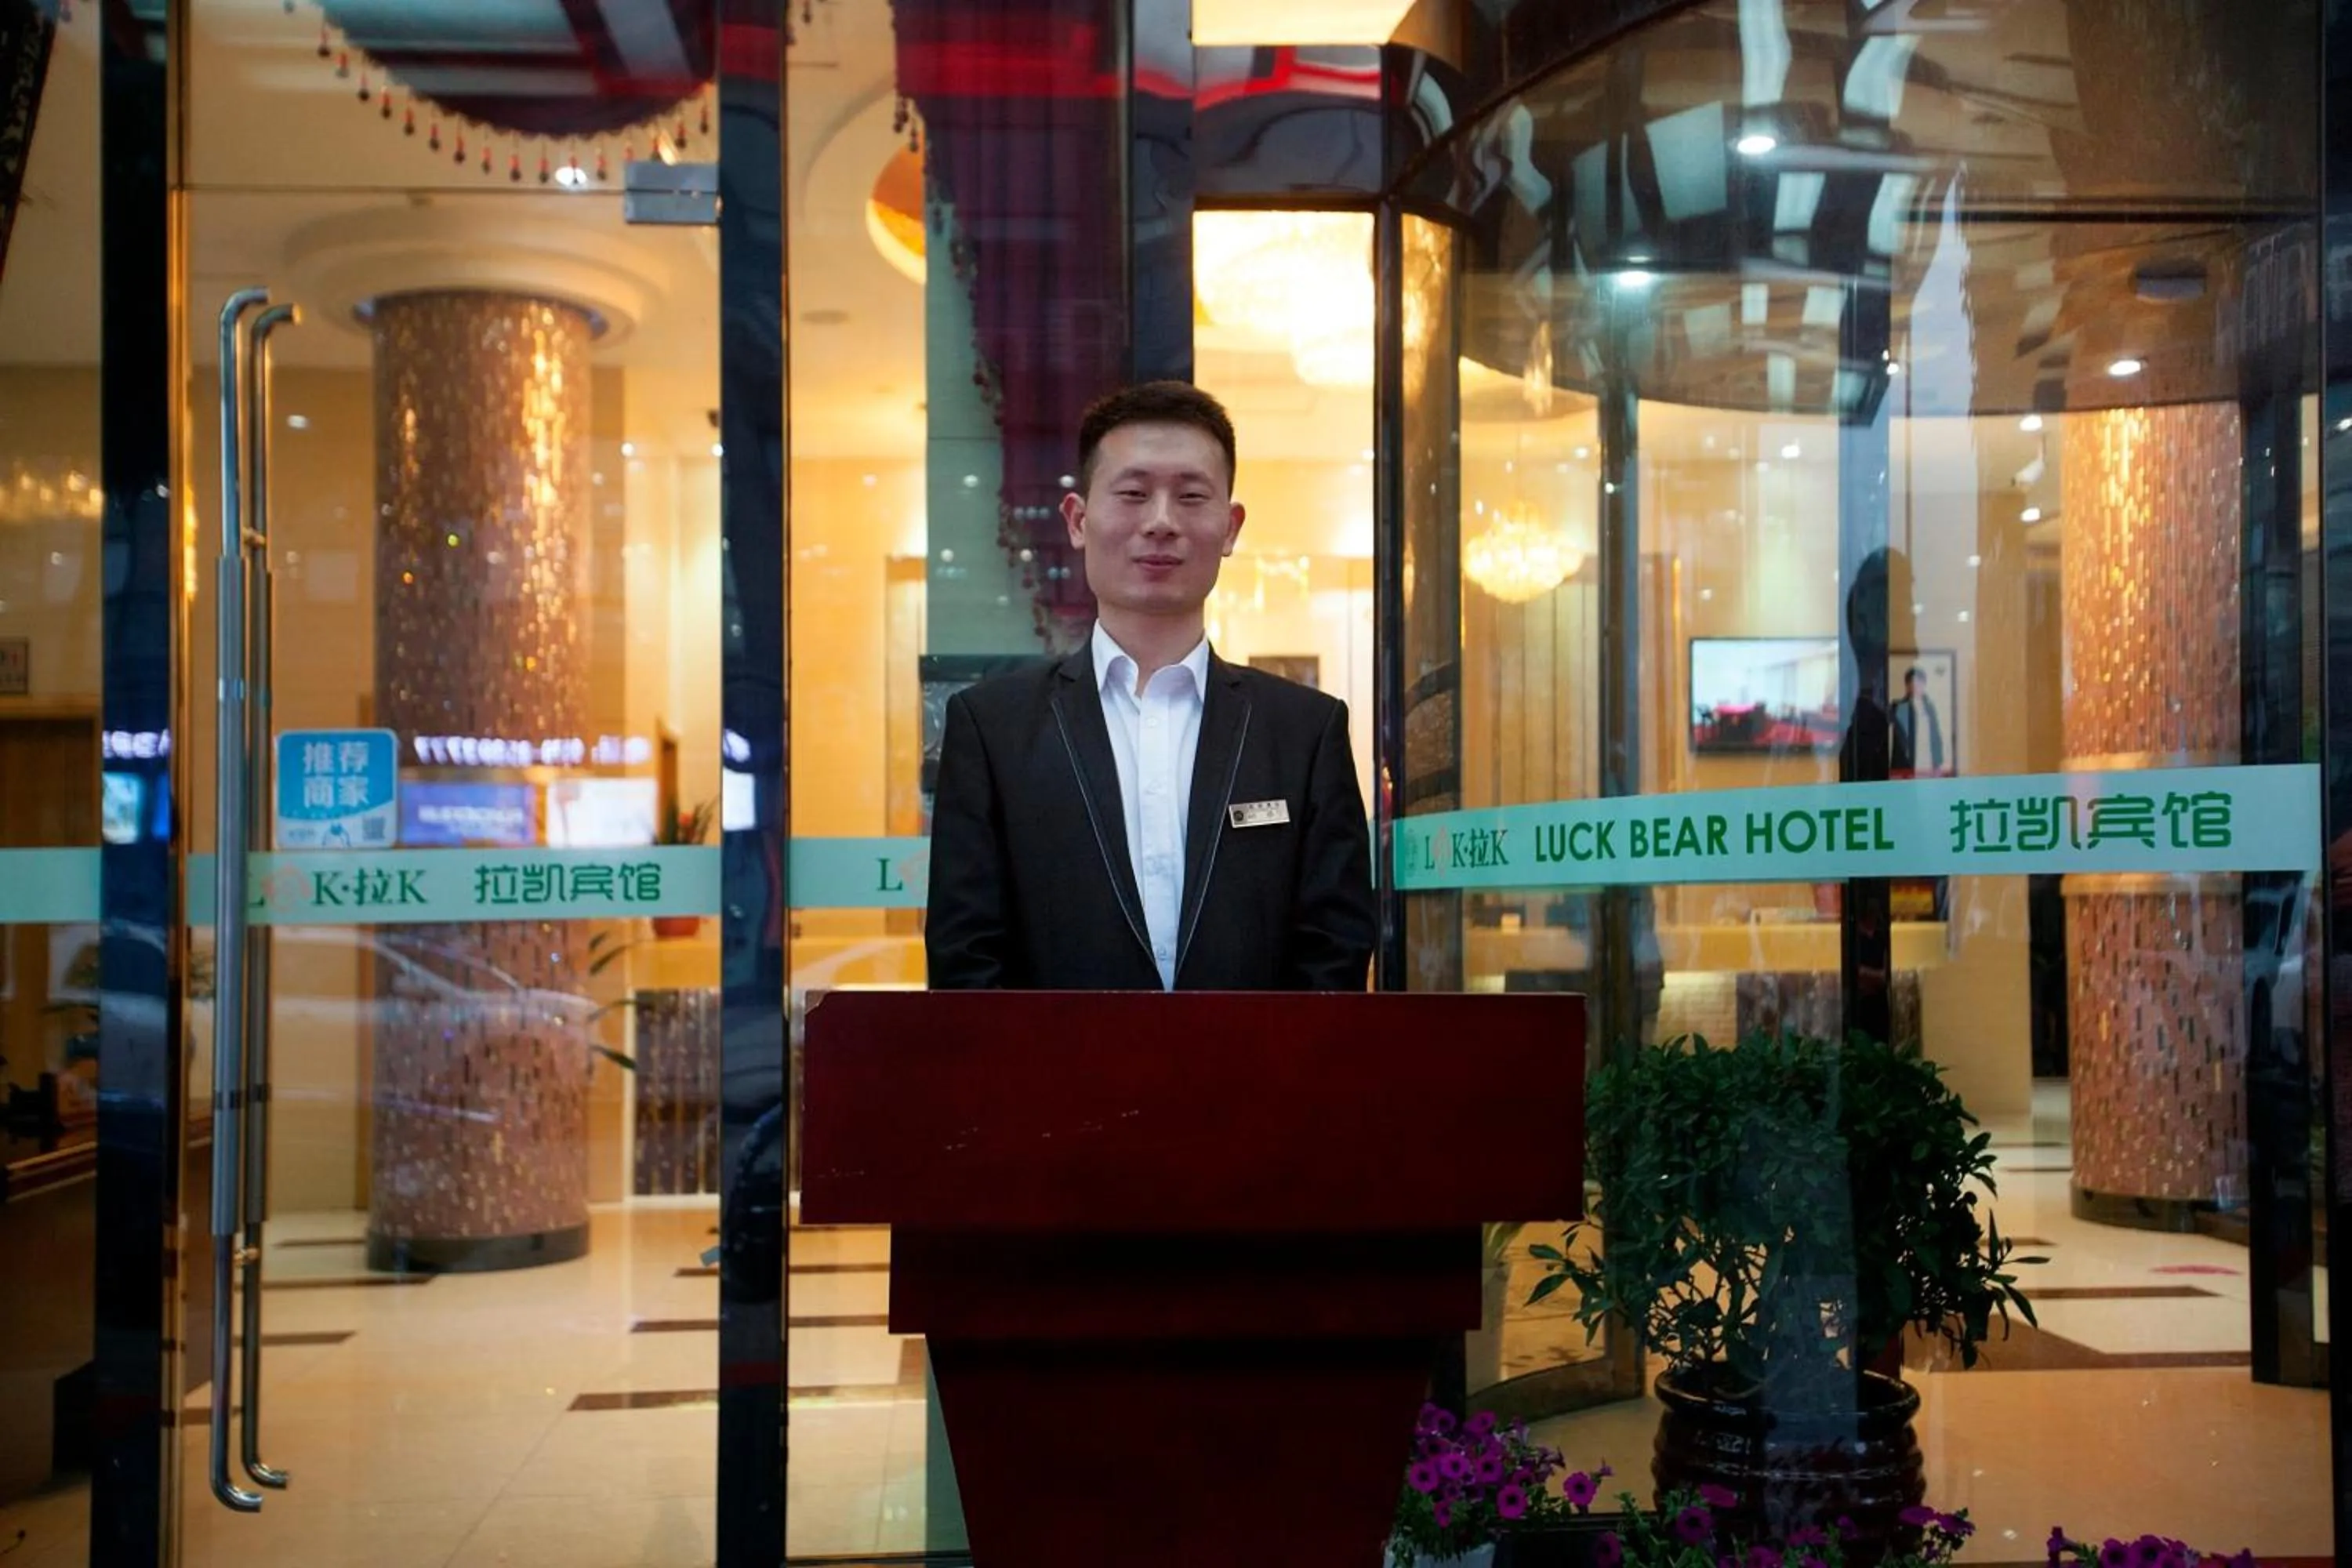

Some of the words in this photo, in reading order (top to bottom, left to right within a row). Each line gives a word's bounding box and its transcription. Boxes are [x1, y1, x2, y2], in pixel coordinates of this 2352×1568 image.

[1535, 820, 1616, 862] LUCK
[1630, 815, 1728, 858] BEAR
[1746, 808, 1895, 854] HOTEL
[1950, 791, 2232, 853] 拉凯宾馆
[474, 862, 662, 904] 拉凯宾馆
